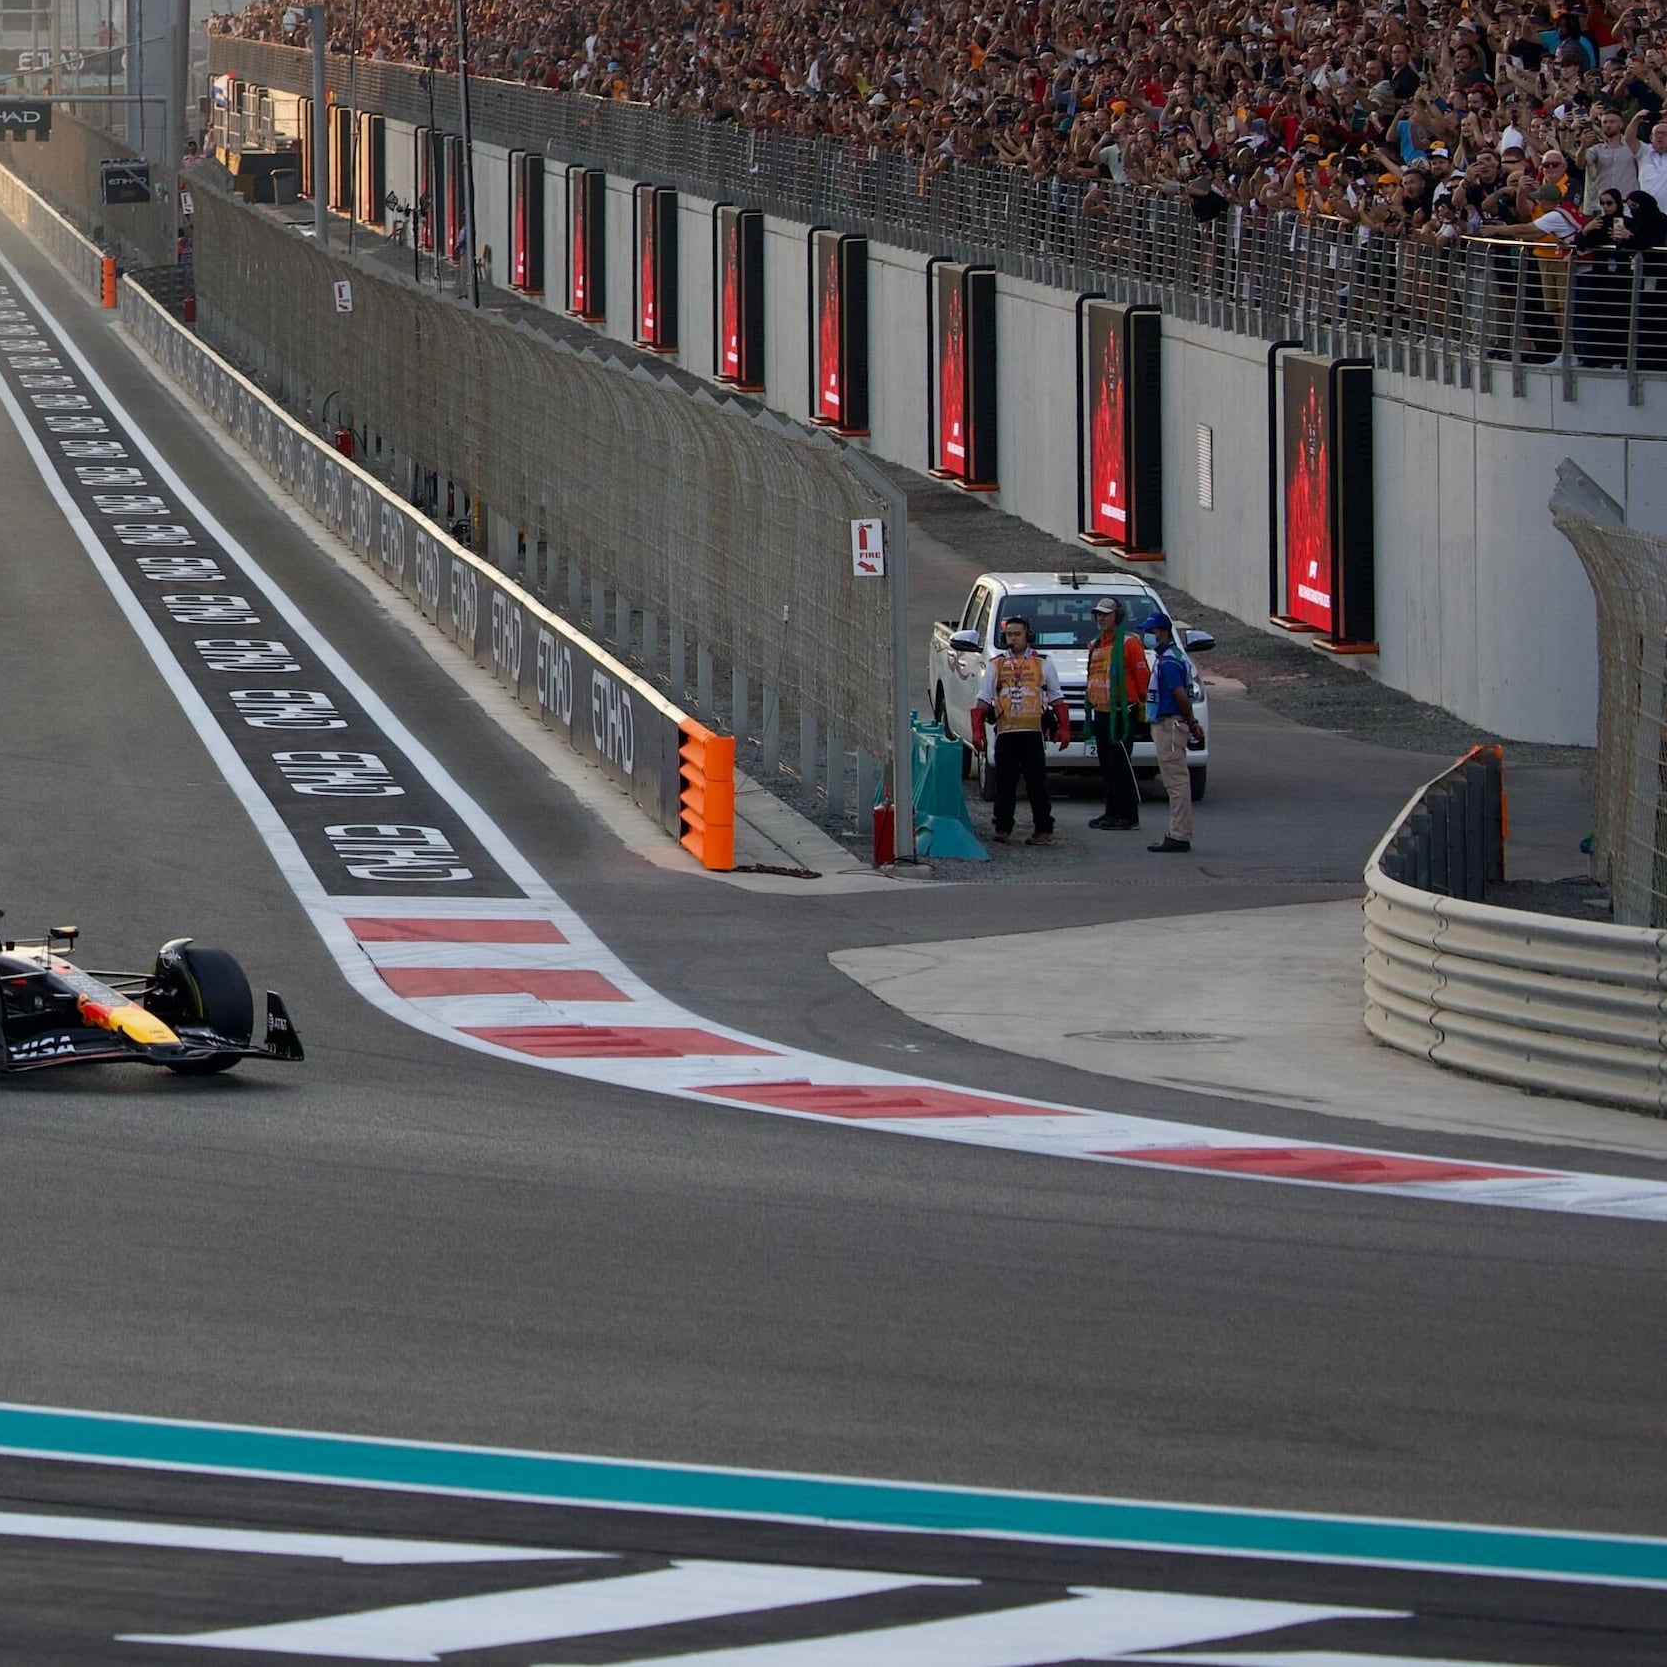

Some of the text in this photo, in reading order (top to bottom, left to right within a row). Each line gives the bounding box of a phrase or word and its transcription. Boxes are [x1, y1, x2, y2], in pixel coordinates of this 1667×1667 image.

[381, 502, 405, 576] ETIHAD
[416, 530, 440, 608] ETIHAD
[859, 551, 881, 559] FIRE
[451, 558, 478, 641] ETIHAD
[491, 590, 522, 681] ETIHAD
[536, 628, 573, 727] ETIHAD
[592, 669, 634, 775] ETIHAD
[7, 1035, 76, 1061] VISA
